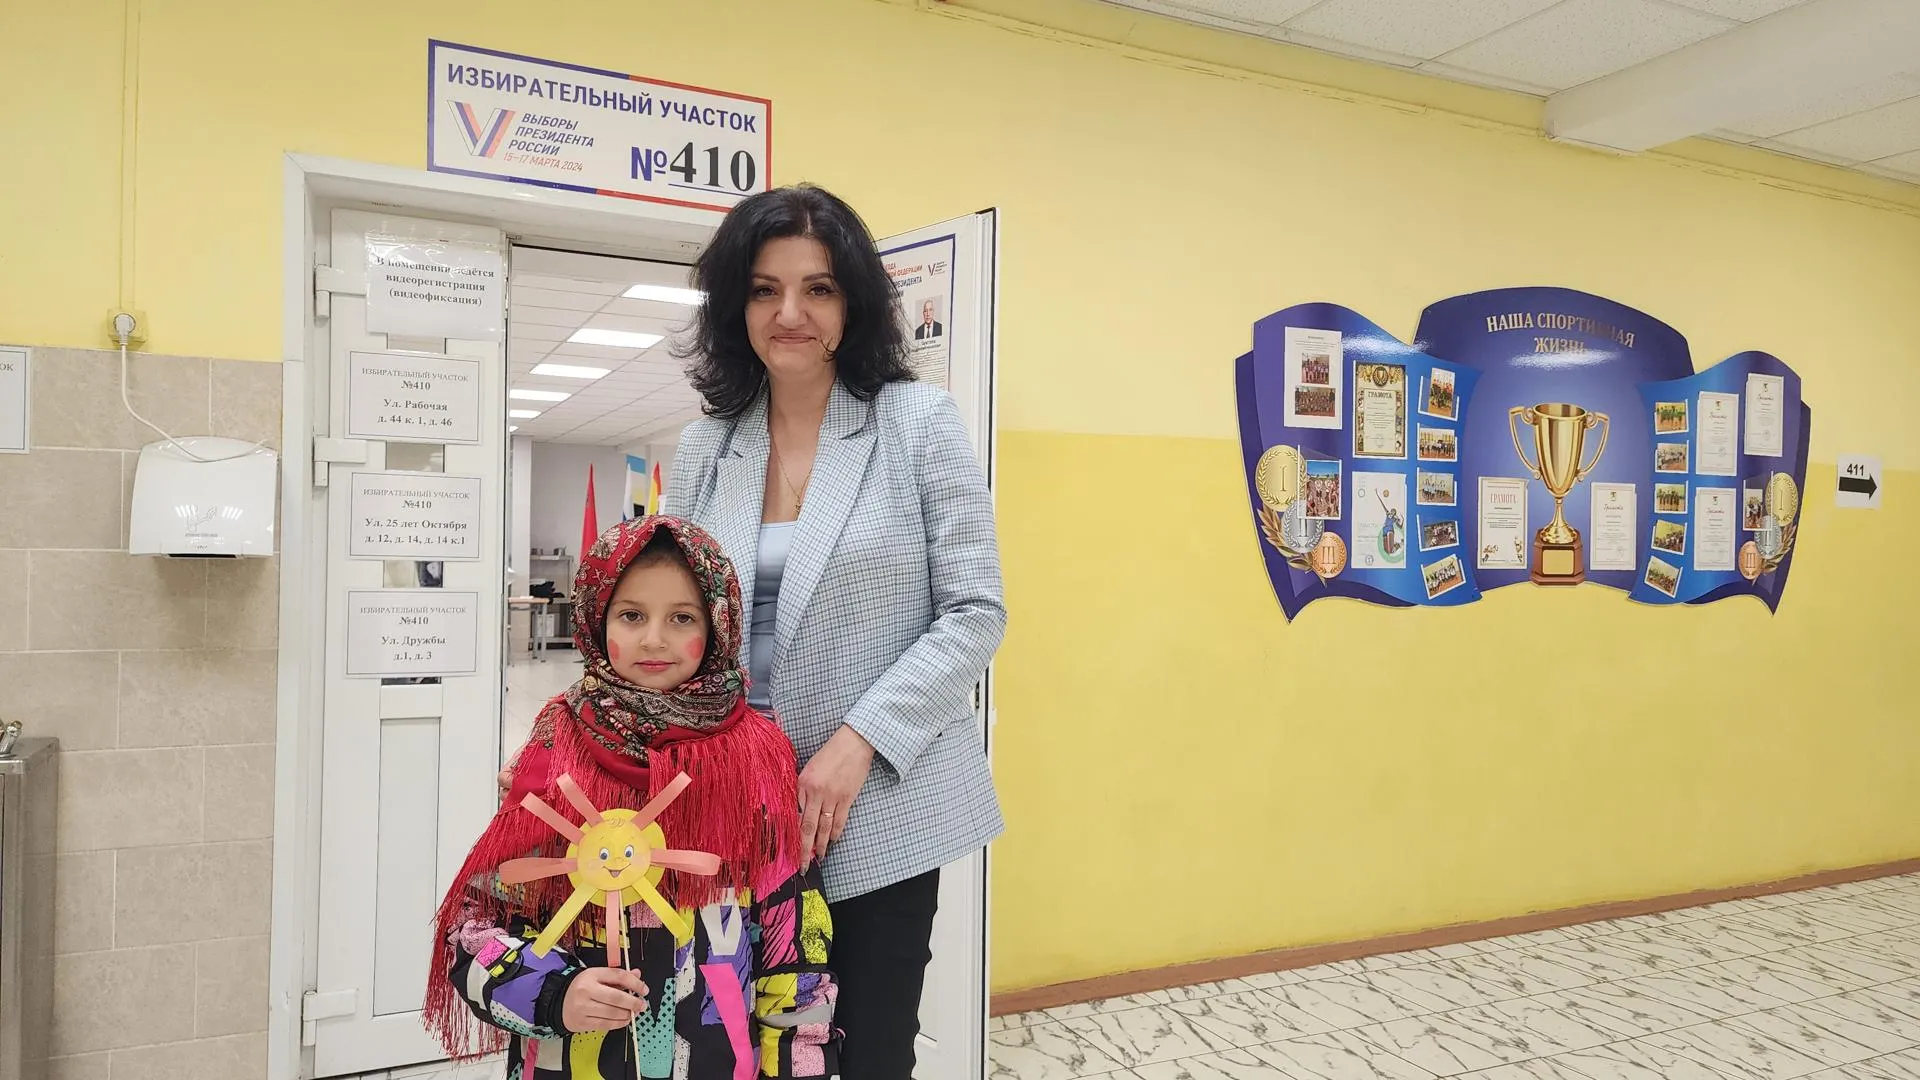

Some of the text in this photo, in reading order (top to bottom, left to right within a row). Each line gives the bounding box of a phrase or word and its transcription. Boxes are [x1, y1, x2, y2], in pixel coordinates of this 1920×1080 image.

[447, 62, 757, 134] ИЗБИРАТЕЛЬНЫЙ УЧАСТОК
[522, 113, 579, 131] ВЫБОРЫ
[515, 126, 594, 147] ПРЕЗИДЕНТА
[508, 139, 561, 156] РОССИИ
[529, 157, 560, 169] МАРТА
[561, 160, 584, 172] 2024
[453, 266, 495, 278] едётся
[386, 273, 486, 292] видеорегистрация
[894, 276, 922, 288] РЕЗИДЕНТА
[389, 287, 482, 307] (видеофиксация)
[1486, 312, 1635, 348] НАША СПОРТИАЯ
[361, 367, 470, 382] ИЗБИРАТЕЛЬНЫЙ УЧАСТОК
[401, 380, 431, 390] №410
[383, 398, 448, 411] Ул. Рабочая
[377, 415, 387, 423] д.
[390, 415, 402, 423] 44
[428, 418, 437, 426] д.
[440, 418, 453, 427] 46
[1846, 463, 1864, 476] 411
[363, 488, 470, 500] ИЗБИРАТЕЛЬНЫЙ УЧАСТОК
[402, 500, 432, 509] №410
[365, 518, 467, 531] Ул. 25 лет Октября
[364, 535, 374, 543] д.
[408, 535, 422, 545] 14,
[424, 536, 434, 544] д.
[437, 535, 448, 544] 14
[360, 606, 466, 614] ИЗБИРАТЕЛЬНЫЙ УЧАСТОК
[399, 616, 429, 625] №410
[381, 636, 446, 647] Ул. Дружбы
[414, 652, 423, 660] д.
[426, 651, 433, 660] 3
